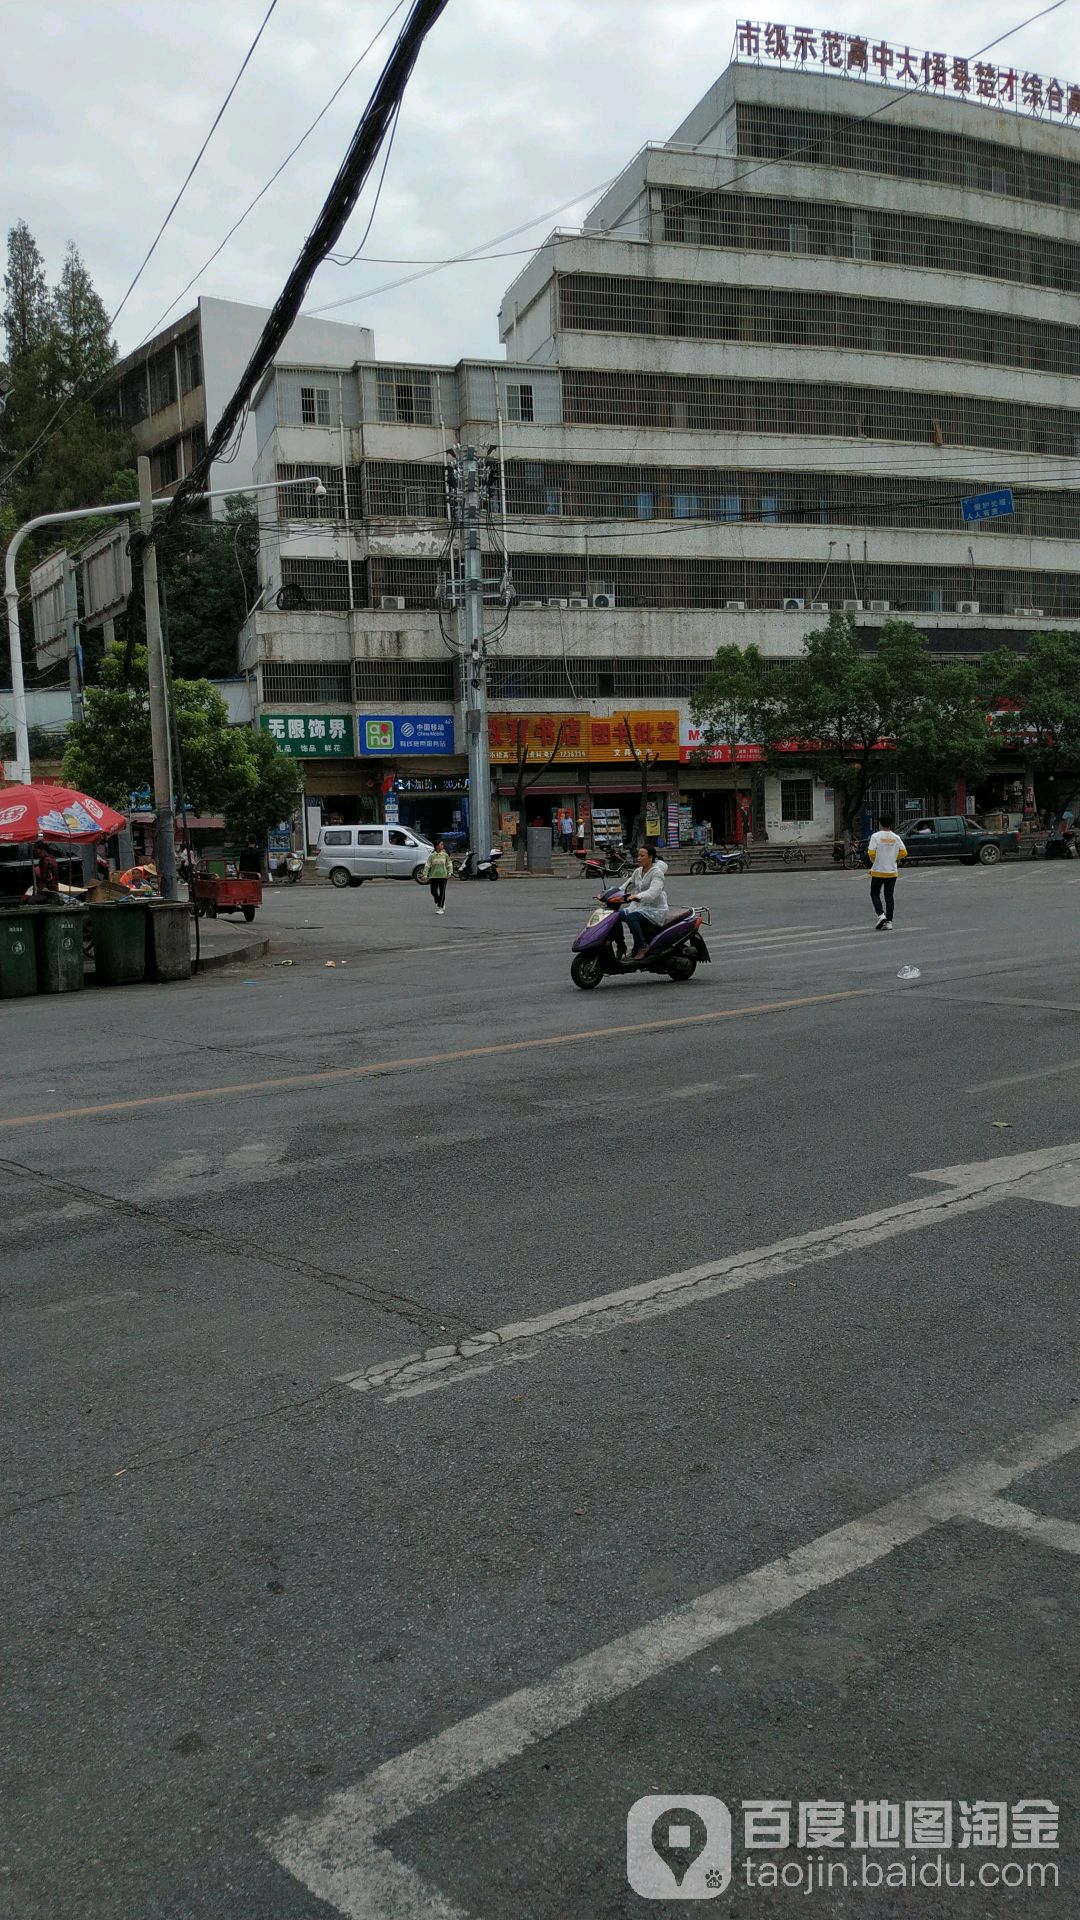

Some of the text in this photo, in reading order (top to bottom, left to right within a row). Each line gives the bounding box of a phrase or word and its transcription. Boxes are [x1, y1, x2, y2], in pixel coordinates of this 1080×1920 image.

[268, 718, 347, 739] 无限饰界
[416, 723, 445, 732] 中国移动
[300, 744, 317, 753] 饰品
[324, 744, 342, 753] 鲜花
